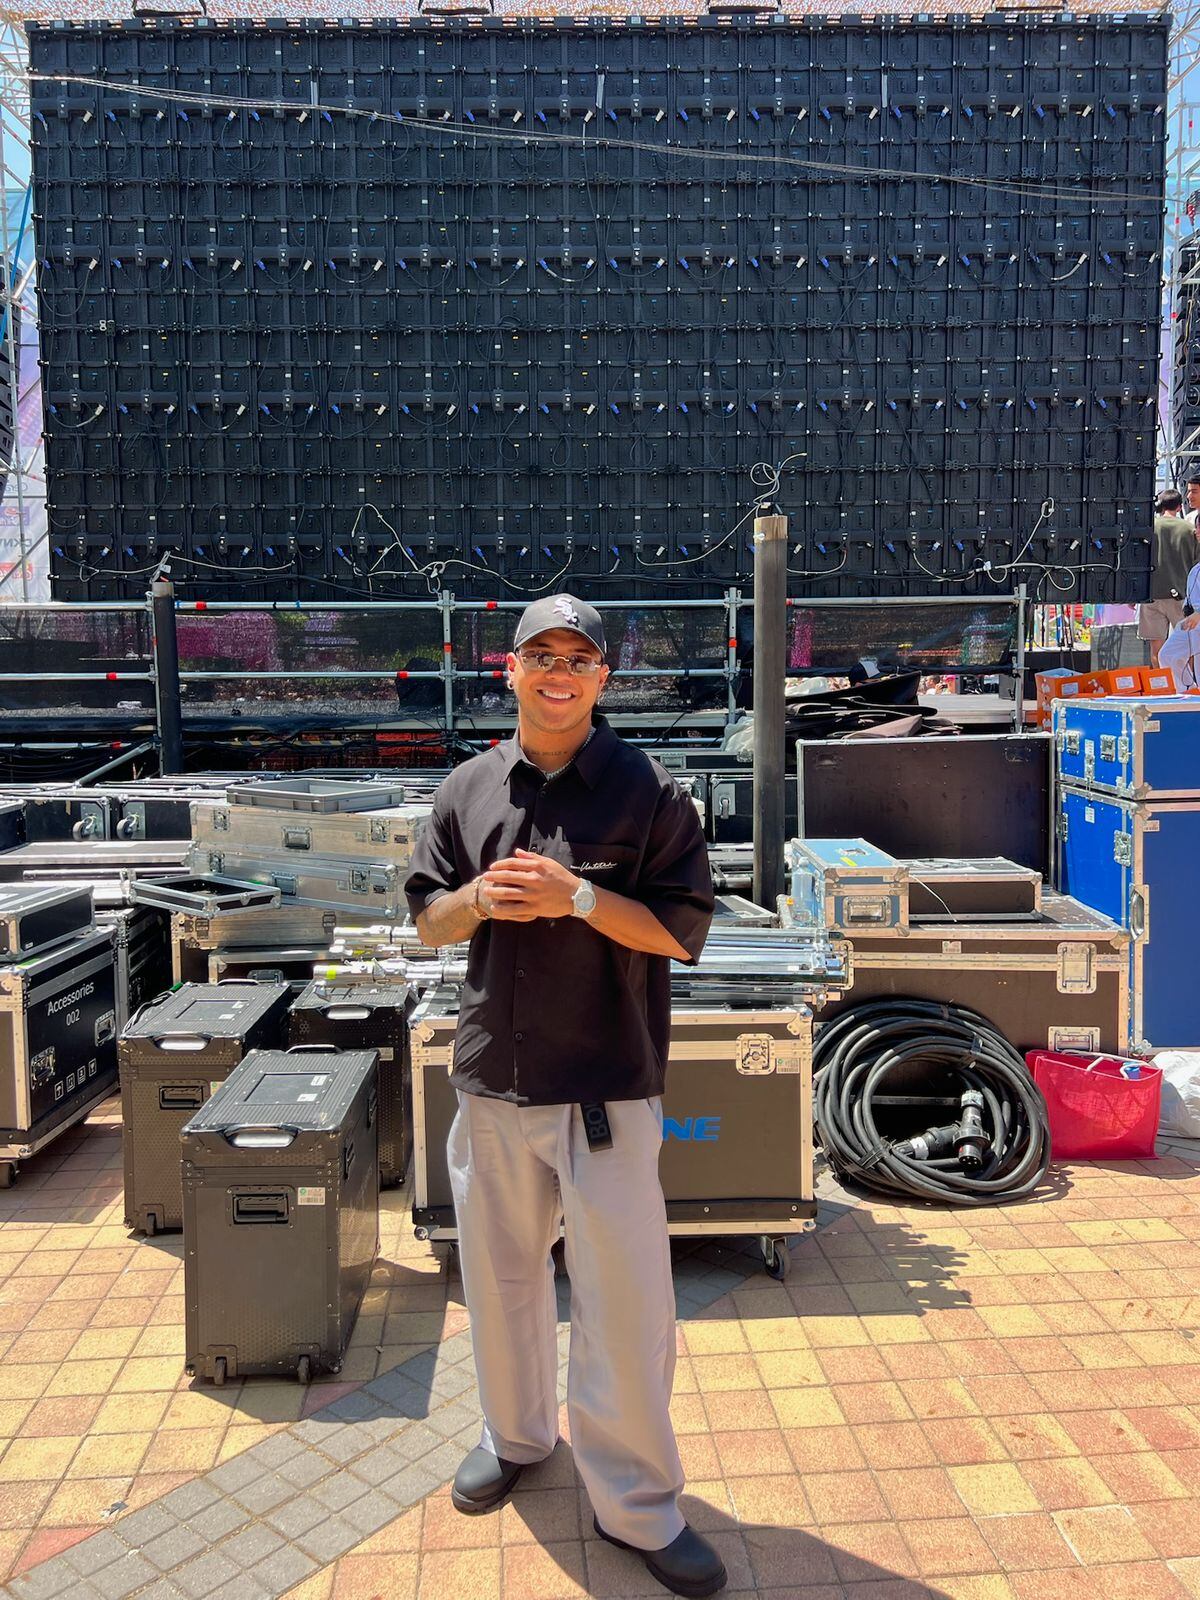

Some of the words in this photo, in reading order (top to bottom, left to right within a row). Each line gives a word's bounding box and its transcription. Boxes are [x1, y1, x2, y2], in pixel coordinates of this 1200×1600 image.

[47, 981, 95, 1016] Accessories
[65, 1008, 81, 1026] 002
[585, 1104, 609, 1138] BO
[662, 1116, 721, 1141] NE
